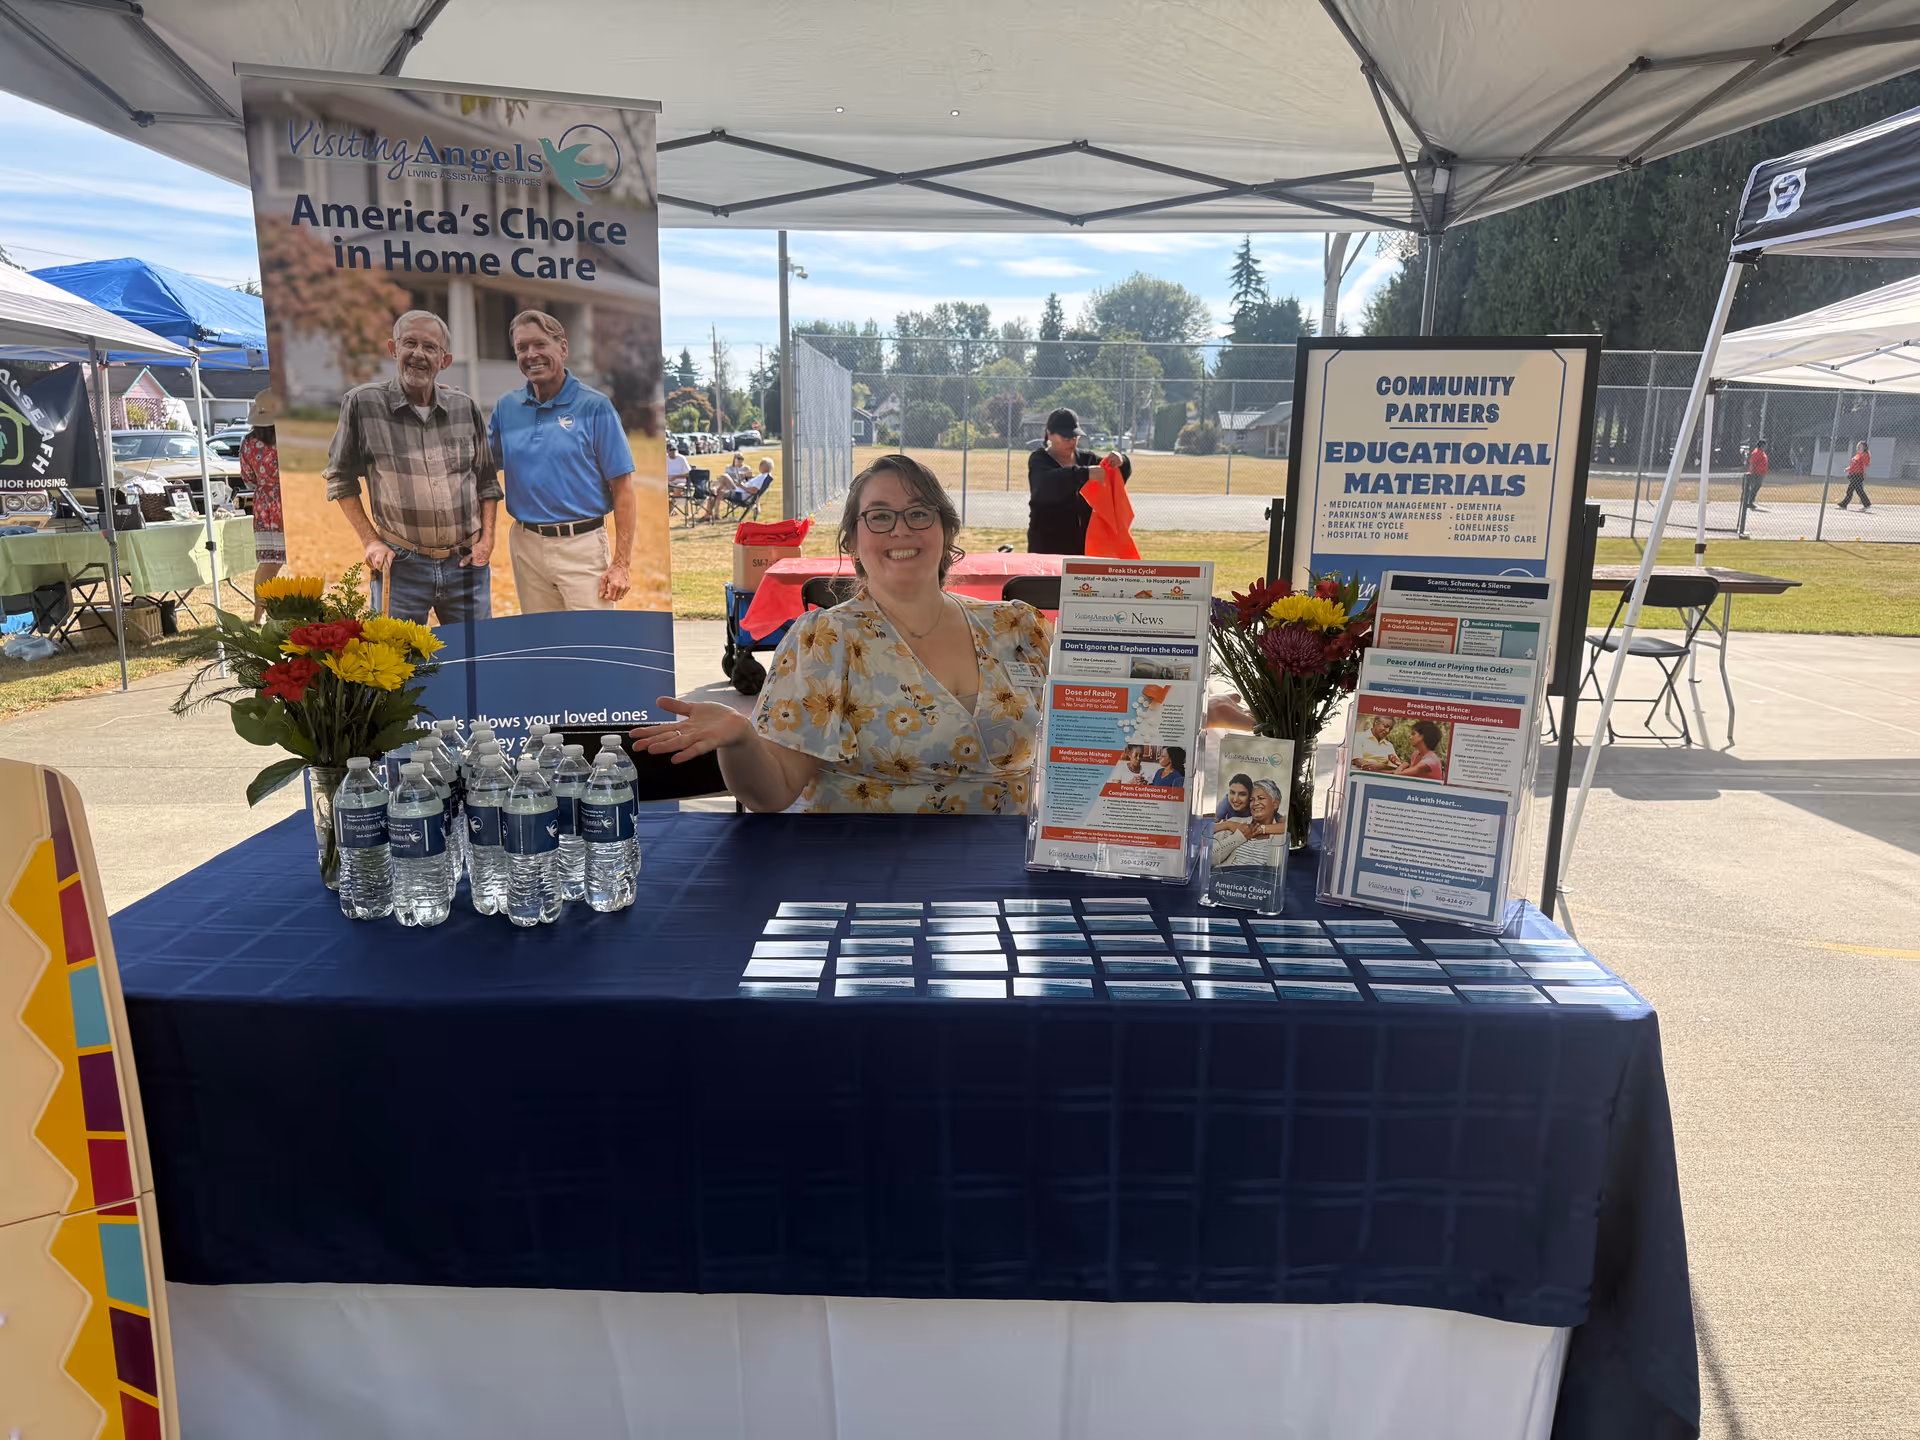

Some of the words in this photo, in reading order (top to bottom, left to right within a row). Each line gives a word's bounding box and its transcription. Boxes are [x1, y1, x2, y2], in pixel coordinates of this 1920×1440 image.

[408, 170, 438, 179] LIVING
[498, 177, 542, 186] SERVICES
[291, 194, 489, 237] America's
[500, 208, 627, 246] Choice
[334, 236, 371, 269] in
[384, 240, 500, 276] Home
[511, 248, 596, 281] Care
[1376, 376, 1515, 396] COMMUNITY
[1385, 403, 1500, 423] PARTNERS
[1324, 442, 1552, 465] EDUCATIONAL
[0, 480, 24, 488] IOR
[26, 478, 68, 488] HOUSING.
[1343, 473, 1526, 497] MATERIALS
[1329, 501, 1383, 509] MEDICATION
[1386, 502, 1447, 511] MANAGEMENT
[1457, 503, 1502, 511] DEMENTIA
[1329, 511, 1386, 519] PARKINSON'S
[1388, 512, 1442, 520] AWARENESS
[1456, 513, 1483, 521] ELDER
[1486, 514, 1515, 522] ABUSE
[1328, 521, 1355, 529] BREAK
[1358, 521, 1373, 529] THE
[1377, 522, 1404, 530] CYCLE
[1455, 524, 1509, 532] LONELINESS
[1327, 531, 1367, 539] HOSPITAL
[1384, 532, 1409, 540] HOME
[1454, 534, 1497, 542] ROADMAP
[1500, 535, 1510, 543] TO
[1514, 535, 1537, 543] CARE
[1131, 613, 1164, 625] News
[1120, 645, 1150, 653] Elephant
[1386, 658, 1406, 666] Peace
[1408, 659, 1417, 667] of
[1418, 660, 1436, 668] Mind
[1447, 663, 1472, 673] Playing
[1473, 665, 1489, 673] the
[1490, 666, 1513, 674] Odds?
[1407, 702, 1434, 711] Breaking
[1447, 706, 1471, 714] Silence:
[525, 713, 560, 729] your
[564, 709, 607, 723] loved
[611, 710, 648, 722] ones
[1422, 711, 1448, 719] Combats
[1471, 716, 1504, 724] Loneliness
[1407, 795, 1422, 803] Ask
[1436, 799, 1462, 808] Heart...
[1215, 882, 1247, 892] America's
[1249, 886, 1272, 896] Choice
[1227, 890, 1246, 898] Home
